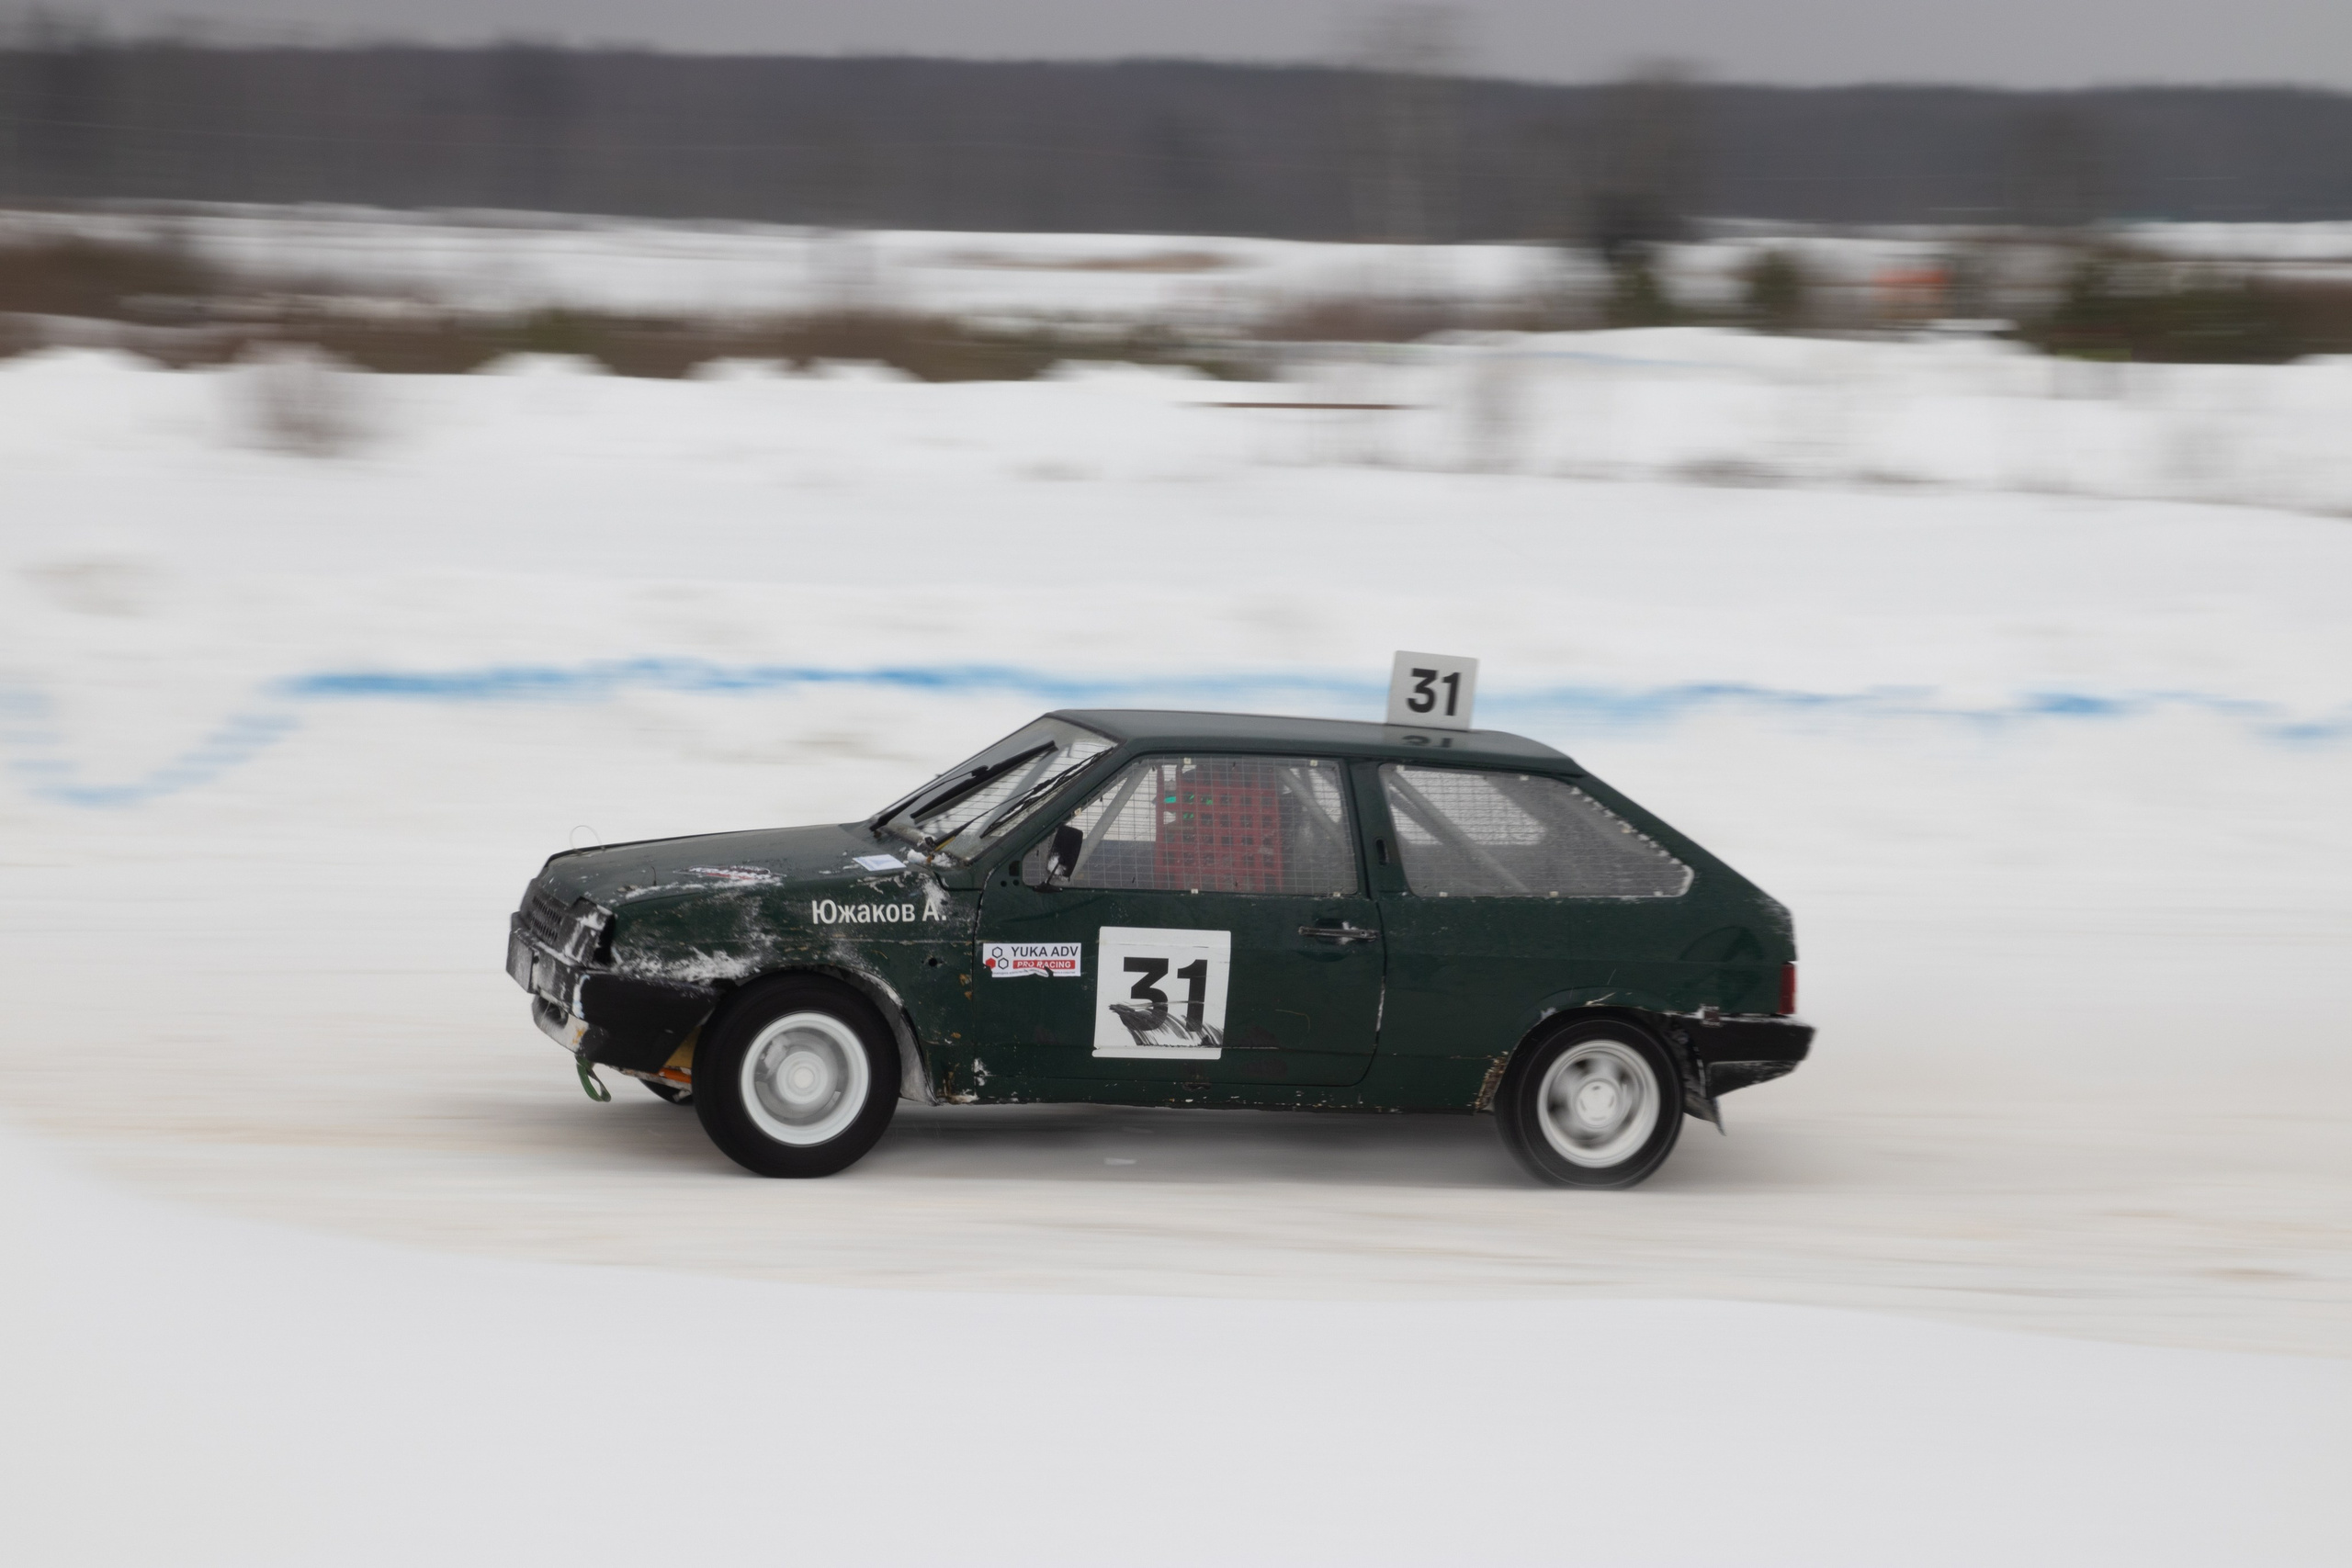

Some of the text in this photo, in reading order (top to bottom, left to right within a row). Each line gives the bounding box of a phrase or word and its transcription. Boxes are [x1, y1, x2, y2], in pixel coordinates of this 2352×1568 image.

[1406, 668, 1461, 716] 31
[811, 897, 947, 925] Южаков А.
[1011, 946, 1079, 957] YUKA ADV
[1035, 961, 1071, 969] RACING
[1119, 956, 1208, 1032] 31
